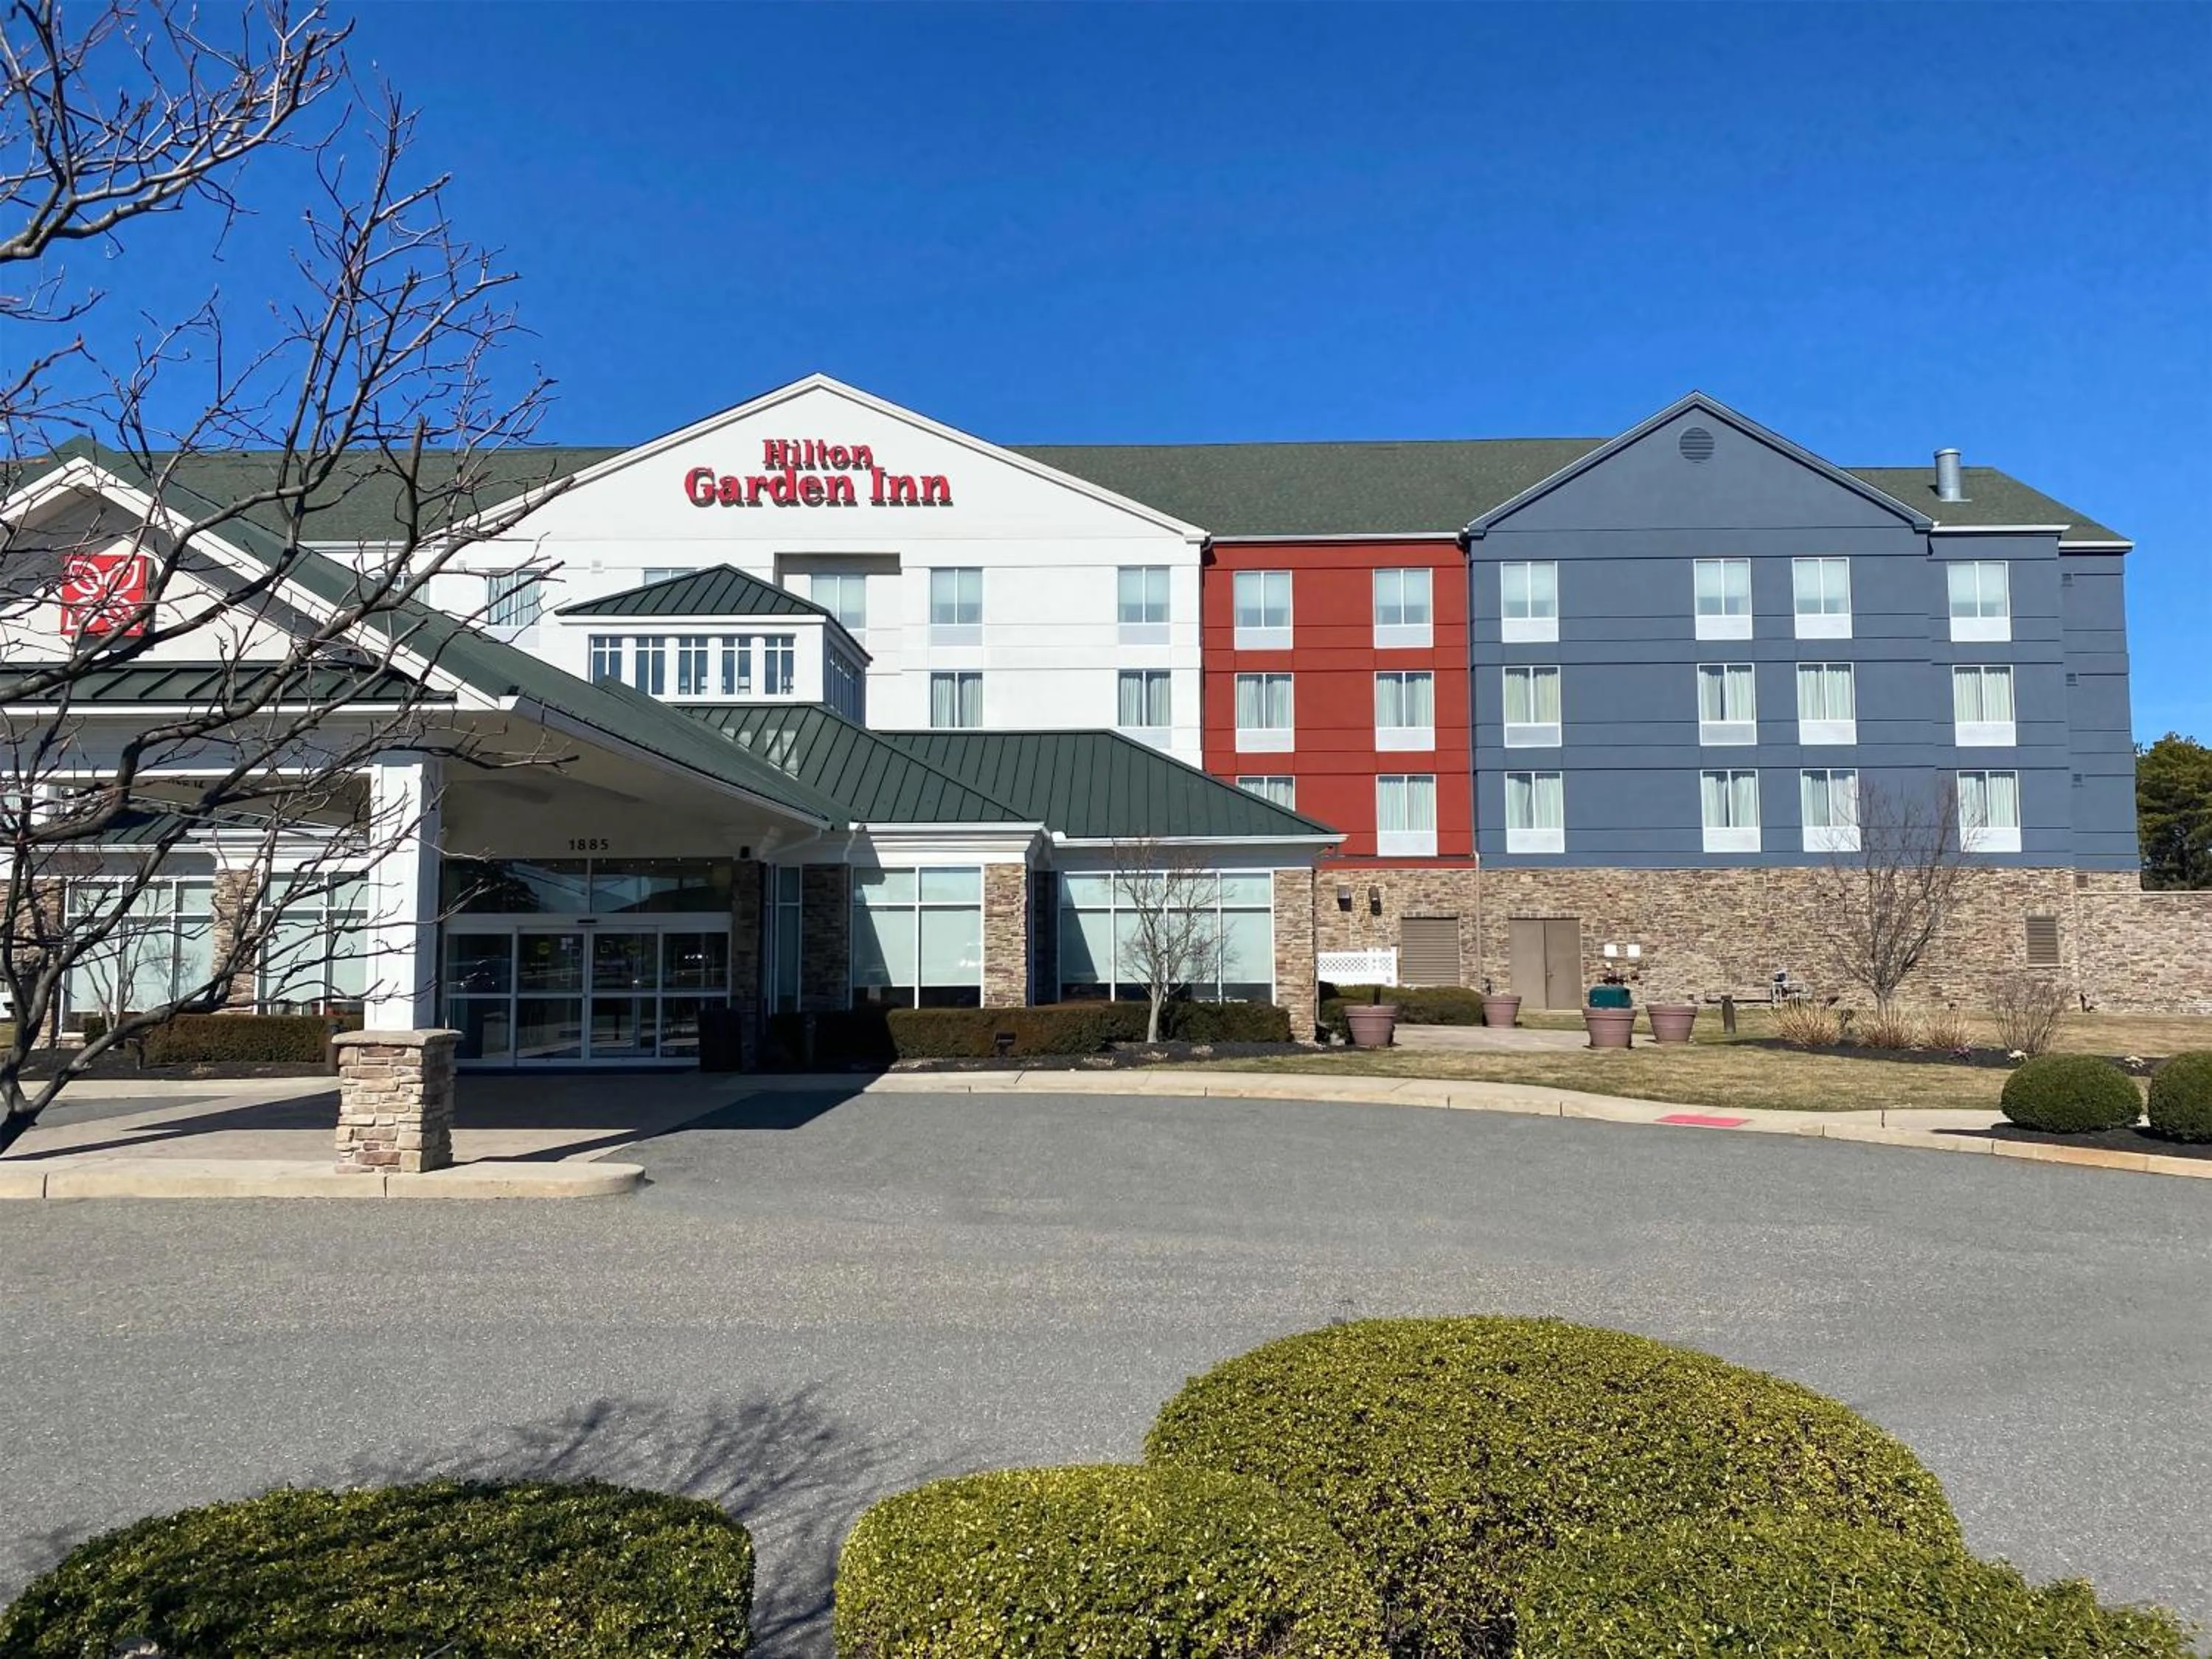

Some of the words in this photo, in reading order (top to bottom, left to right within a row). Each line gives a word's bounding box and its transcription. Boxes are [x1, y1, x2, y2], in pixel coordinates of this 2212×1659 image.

[762, 439, 873, 470] Hilton
[684, 466, 858, 507] Garden
[869, 466, 953, 507] Inn
[568, 838, 610, 851] 1885
